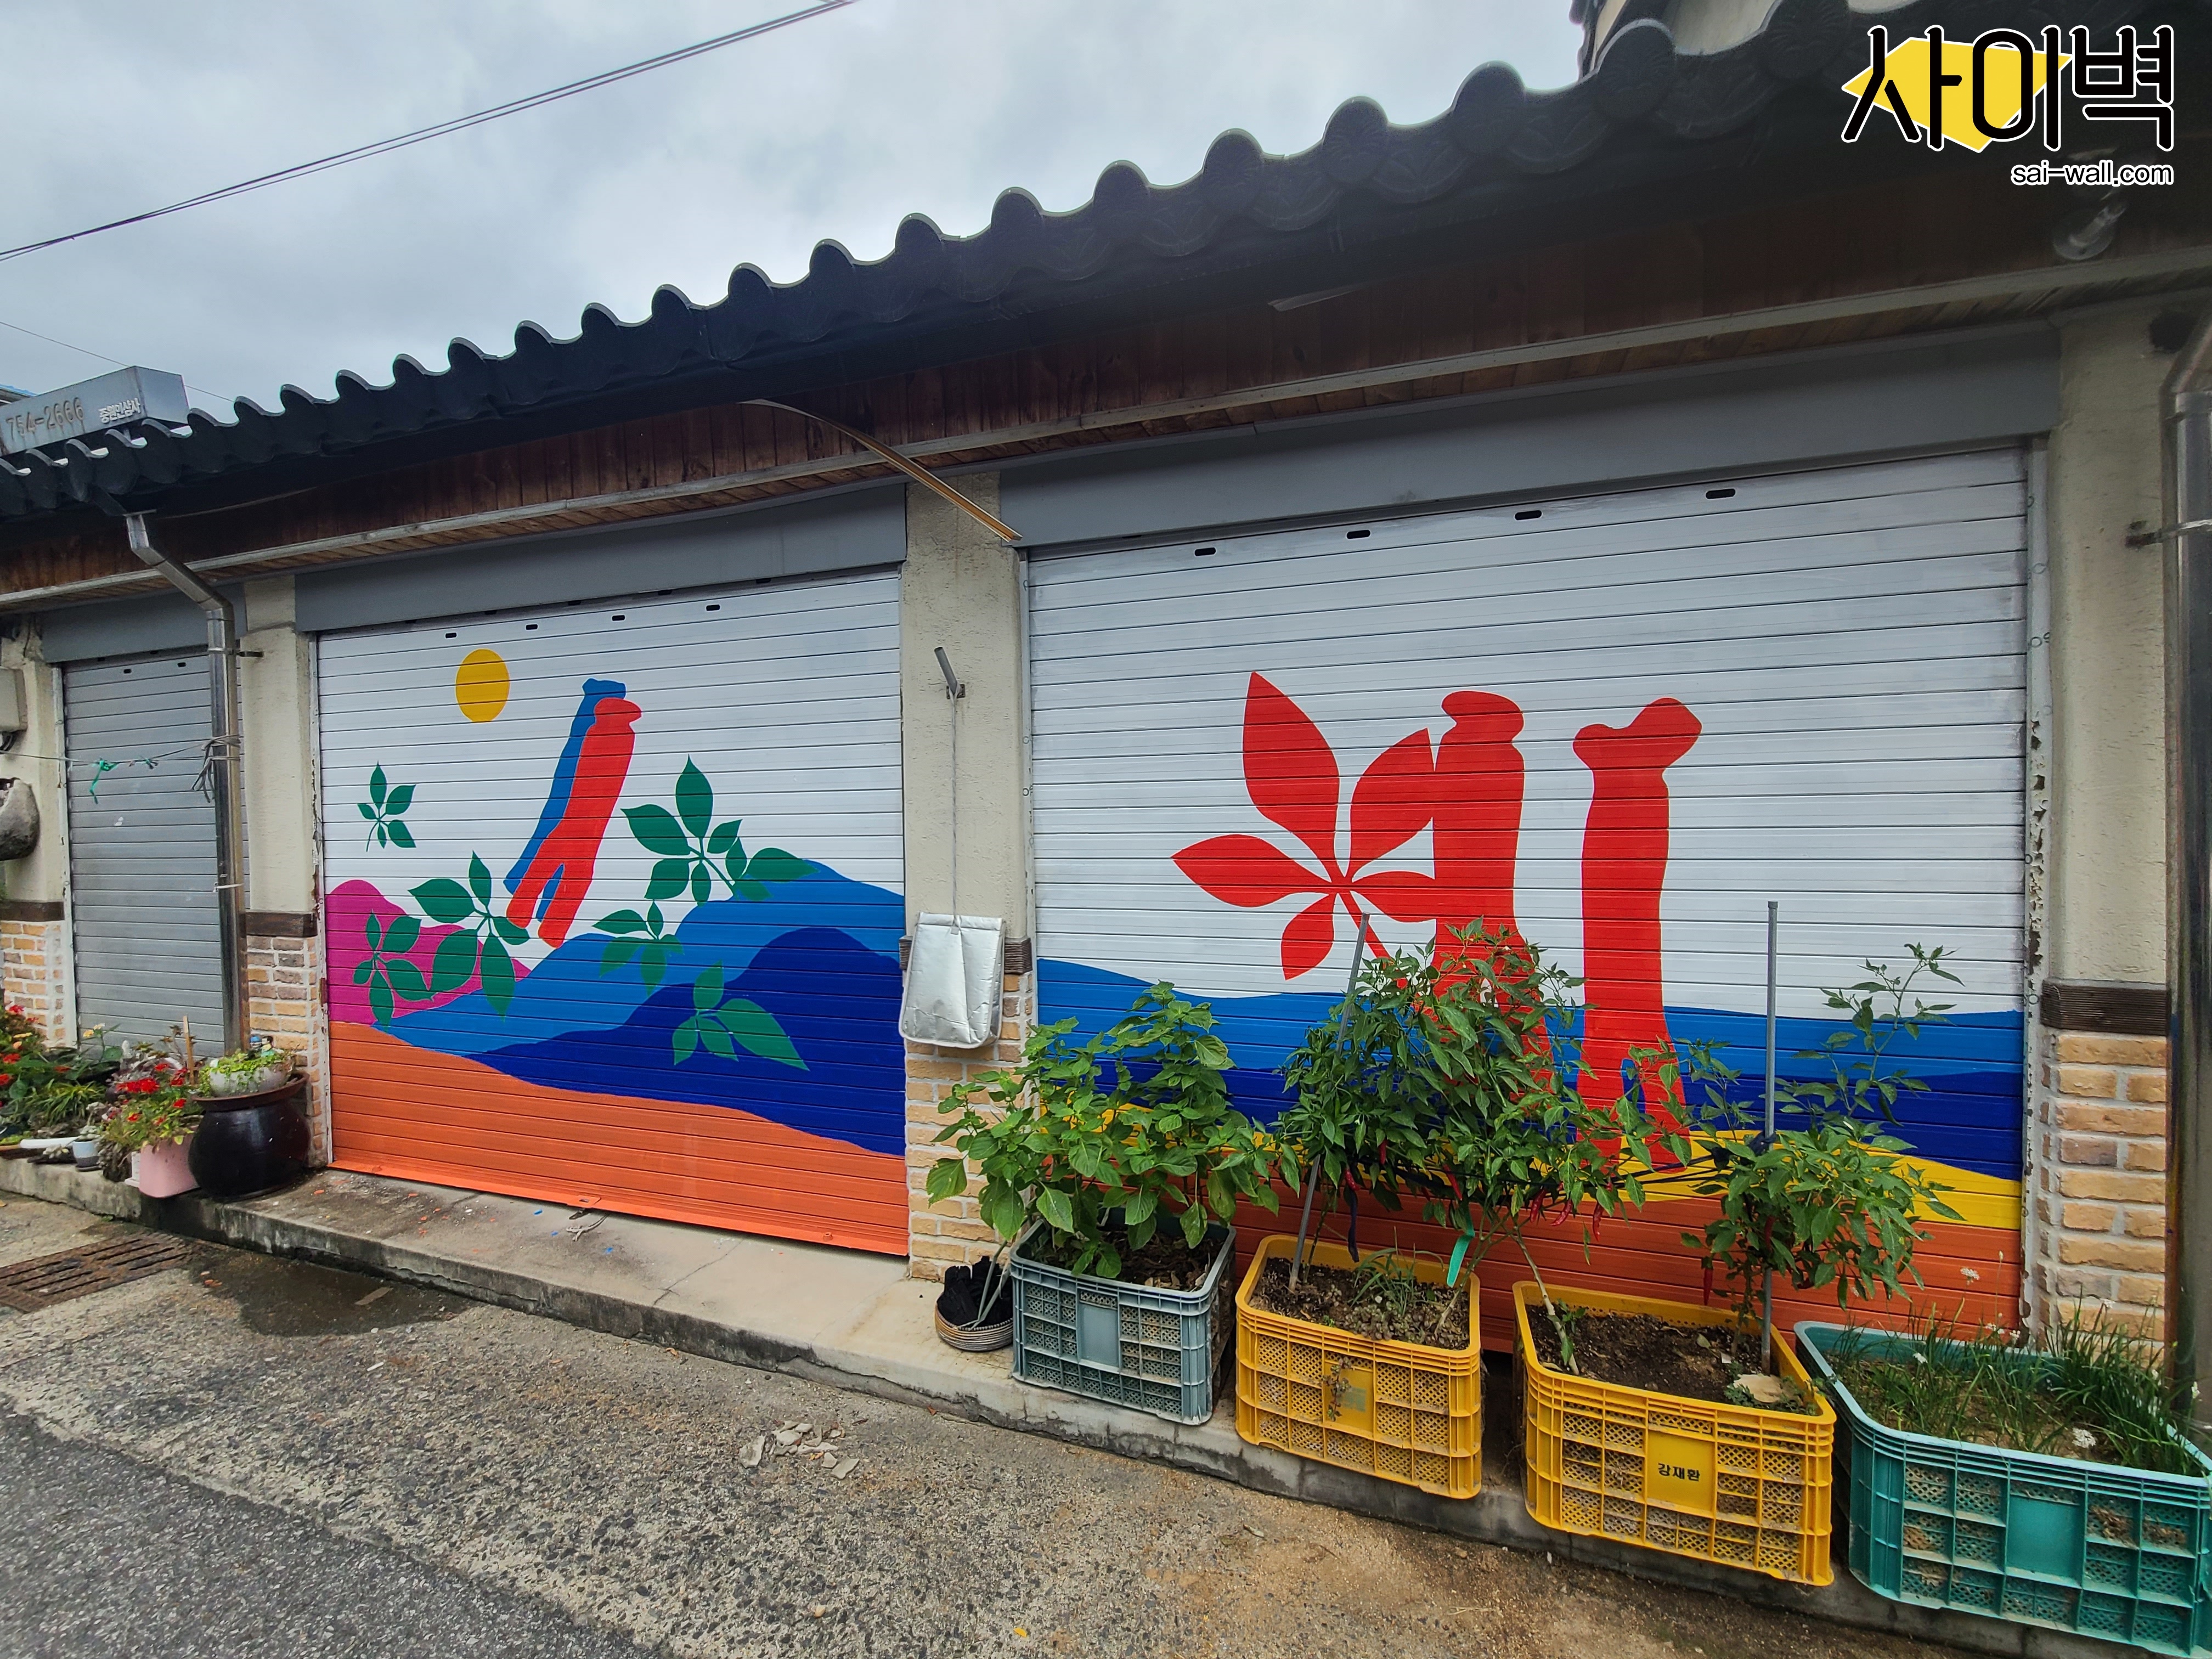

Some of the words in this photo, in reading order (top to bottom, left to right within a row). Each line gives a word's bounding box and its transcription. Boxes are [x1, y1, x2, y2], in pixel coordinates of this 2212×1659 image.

[5, 397, 84, 440] 754-2666
[98, 398, 141, 424] 중원인삼사
[1658, 1462, 1700, 1482] 강재환
